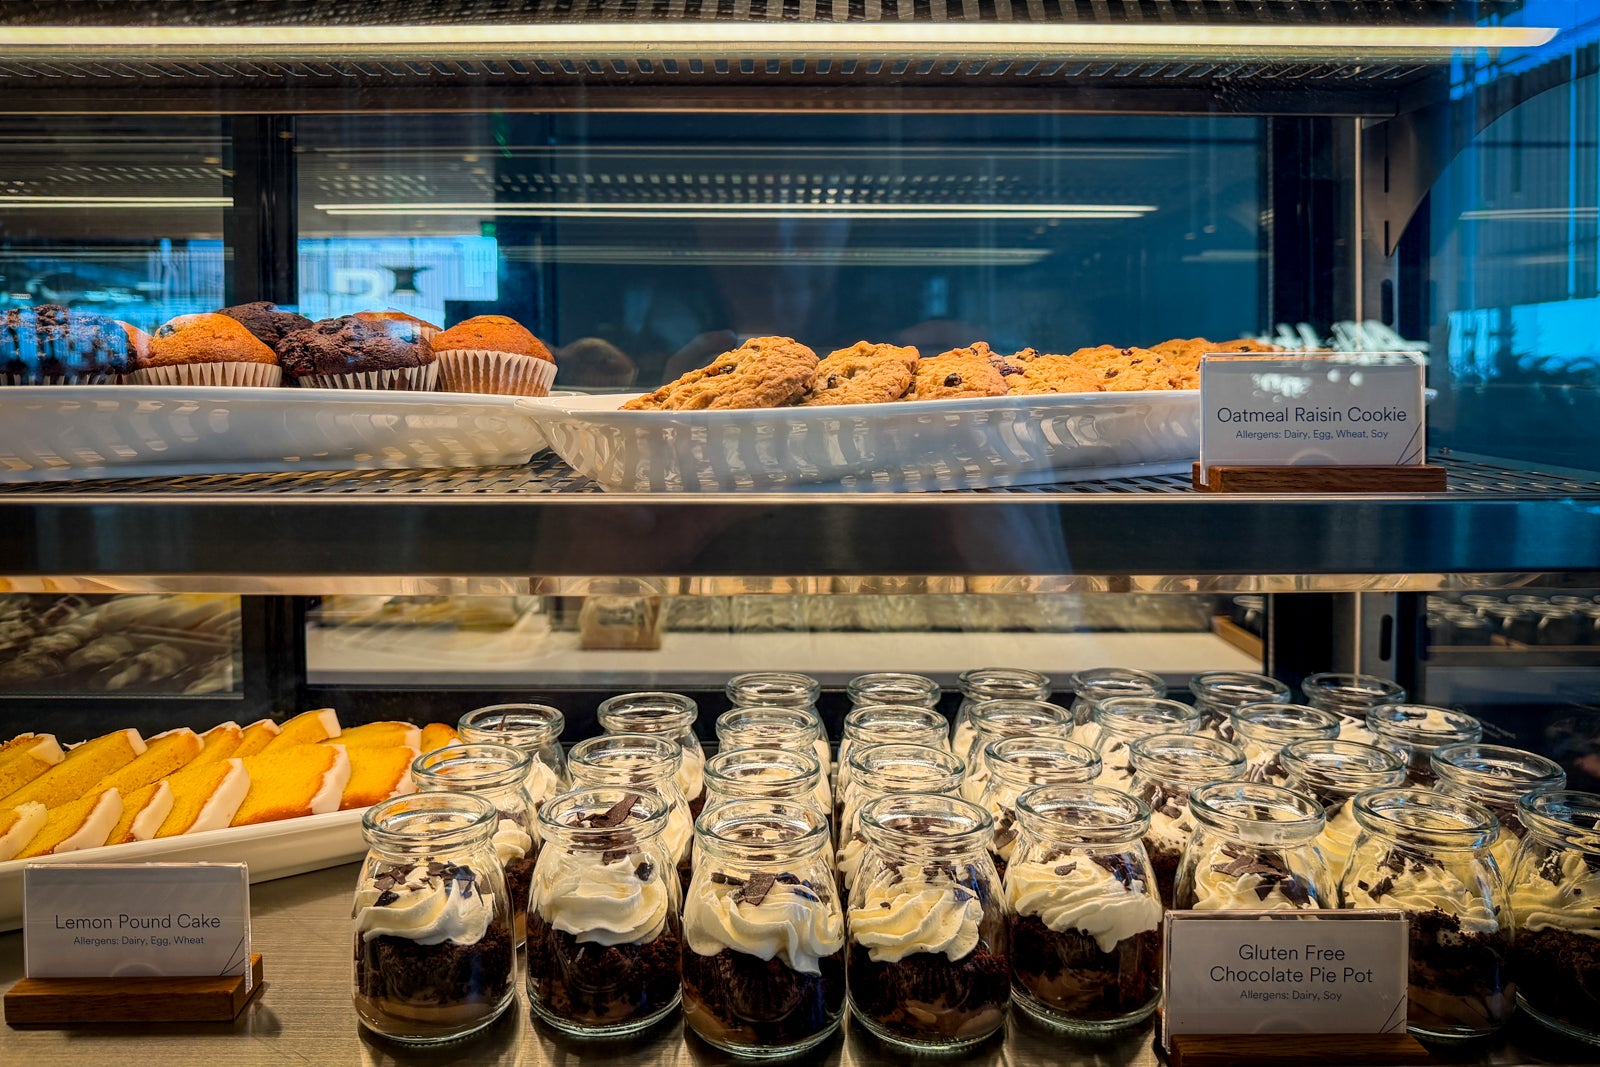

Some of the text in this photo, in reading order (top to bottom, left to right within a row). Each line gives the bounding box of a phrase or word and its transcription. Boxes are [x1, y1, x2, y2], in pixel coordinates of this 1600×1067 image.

[1217, 407, 1407, 423] Oatmeal Raisin Cookie
[1236, 429, 1388, 440] Allergens: Dairy, Egg, Wheat, Soy
[56, 913, 221, 930] Lemon Pound Cake
[73, 936, 204, 946] Allergens: Dairy, Egg, Wheat
[1238, 944, 1345, 961] Gluten Free
[1210, 966, 1373, 983] Chocolate Pie Pot
[1240, 991, 1342, 1001] Allergens: Dairy, Soy
